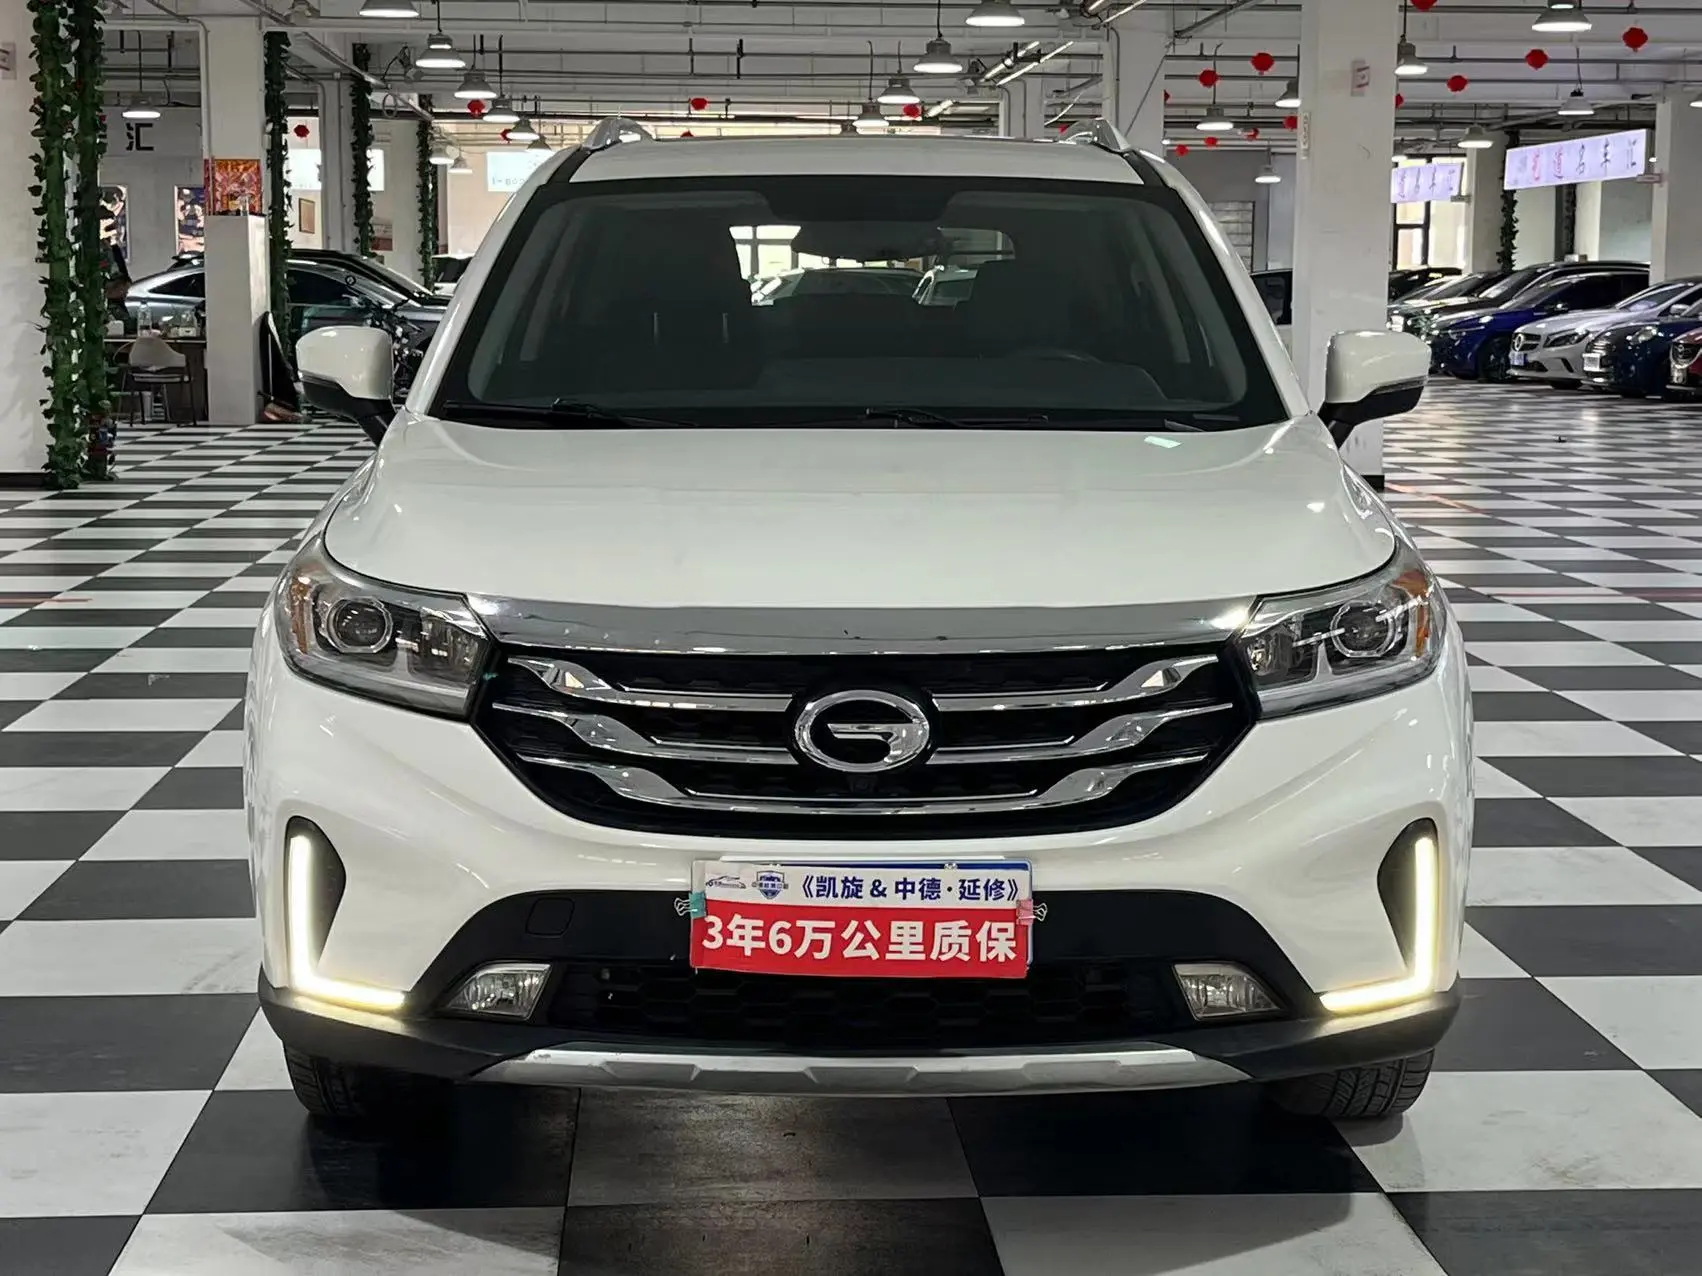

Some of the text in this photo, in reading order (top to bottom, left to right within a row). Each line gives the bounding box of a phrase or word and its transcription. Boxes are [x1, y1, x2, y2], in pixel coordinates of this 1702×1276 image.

[703, 915, 1017, 962] 3年6万公里质保
